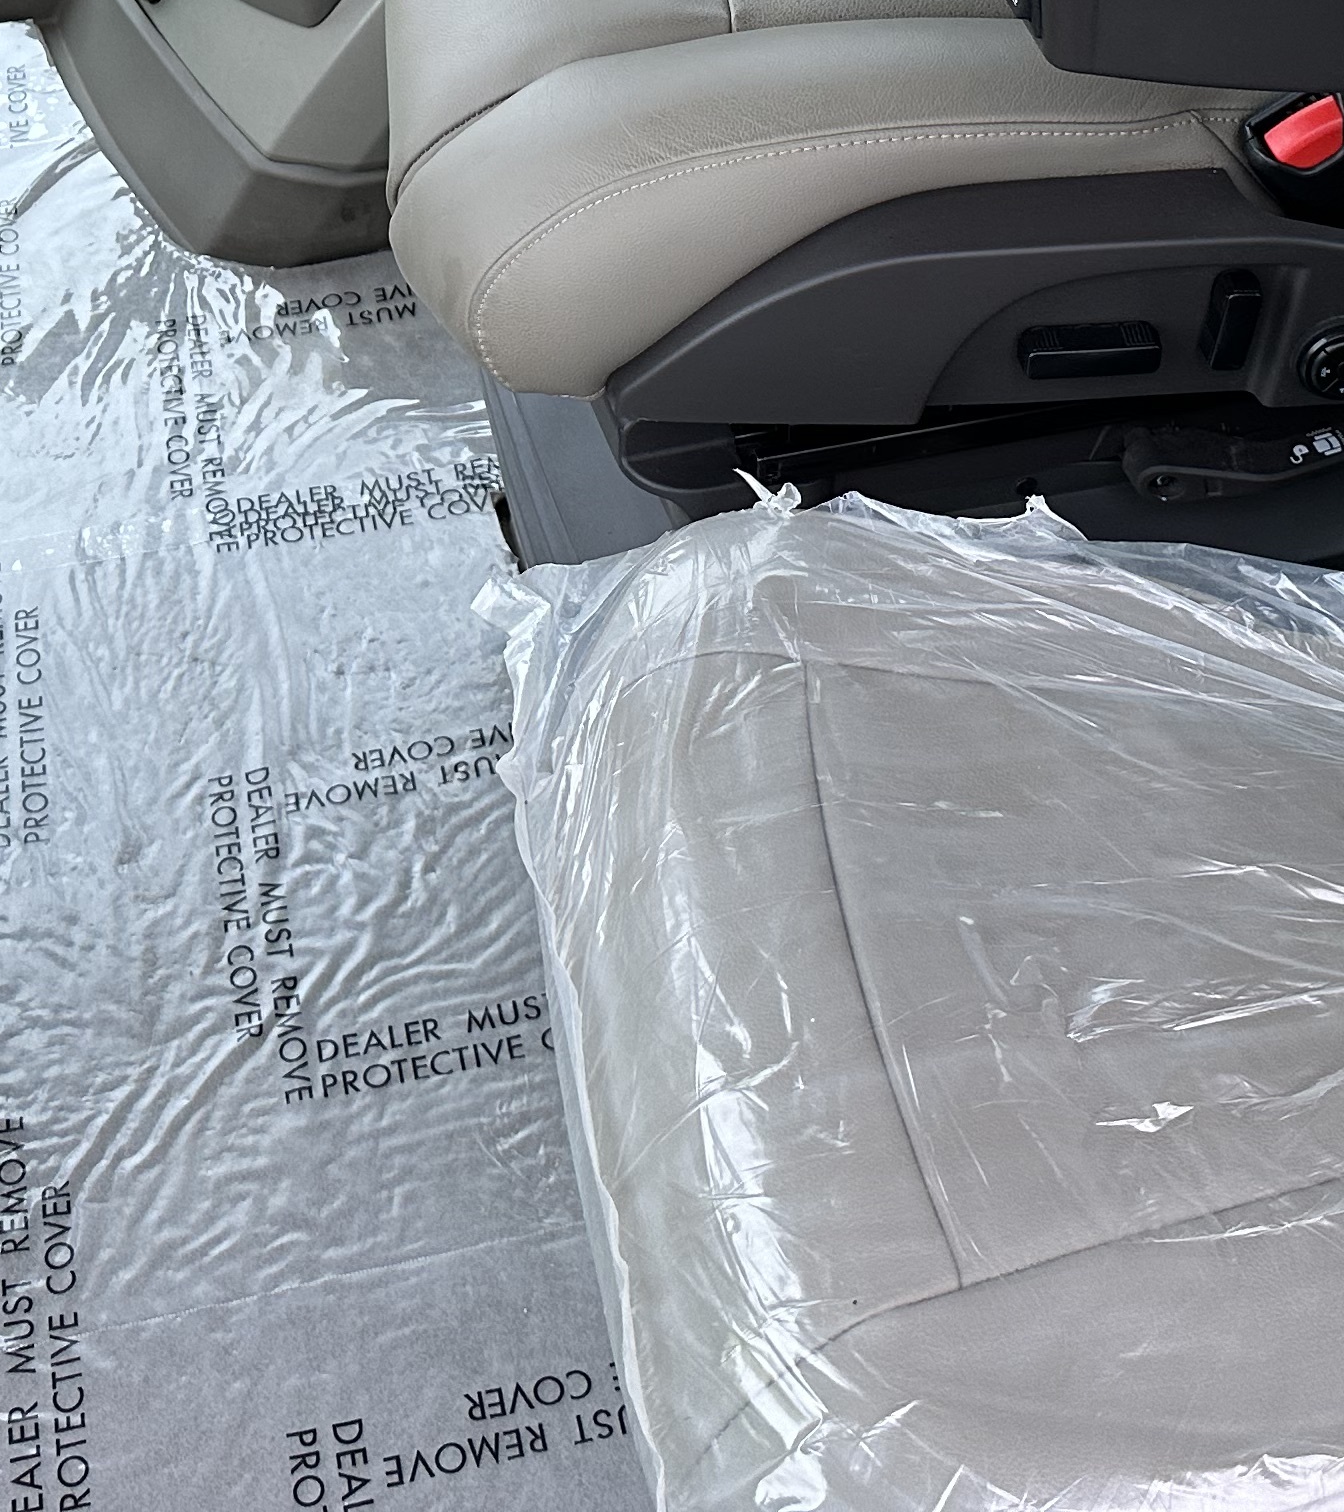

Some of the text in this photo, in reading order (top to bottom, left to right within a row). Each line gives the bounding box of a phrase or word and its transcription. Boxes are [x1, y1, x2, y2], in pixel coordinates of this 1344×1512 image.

[7, 64, 28, 112] COVER
[0, 262, 23, 368] PROTECTIVE
[277, 290, 362, 317] COVER
[349, 302, 417, 327] MUST
[186, 314, 214, 380] DEALER
[156, 318, 194, 500] PROTECTIVE COVER
[194, 394, 224, 445] MUST
[236, 484, 338, 513] DEALER
[246, 508, 415, 549] PROTECTIVE
[14, 604, 49, 845] PROTECTIVE COVER
[351, 734, 456, 773] COVER
[284, 753, 503, 815] UST REMOVE
[207, 774, 264, 1043] PROTECTIVE COVER
[244, 766, 314, 1106] DEALER MUST REMOVE
[316, 1018, 442, 1064] DEALER
[321, 1033, 526, 1098] PROTECTIVE
[42, 1180, 80, 1296] COVER
[1, 1278, 37, 1375] MUST
[464, 1369, 593, 1423] COVER
[383, 1422, 549, 1489] REMOVE
